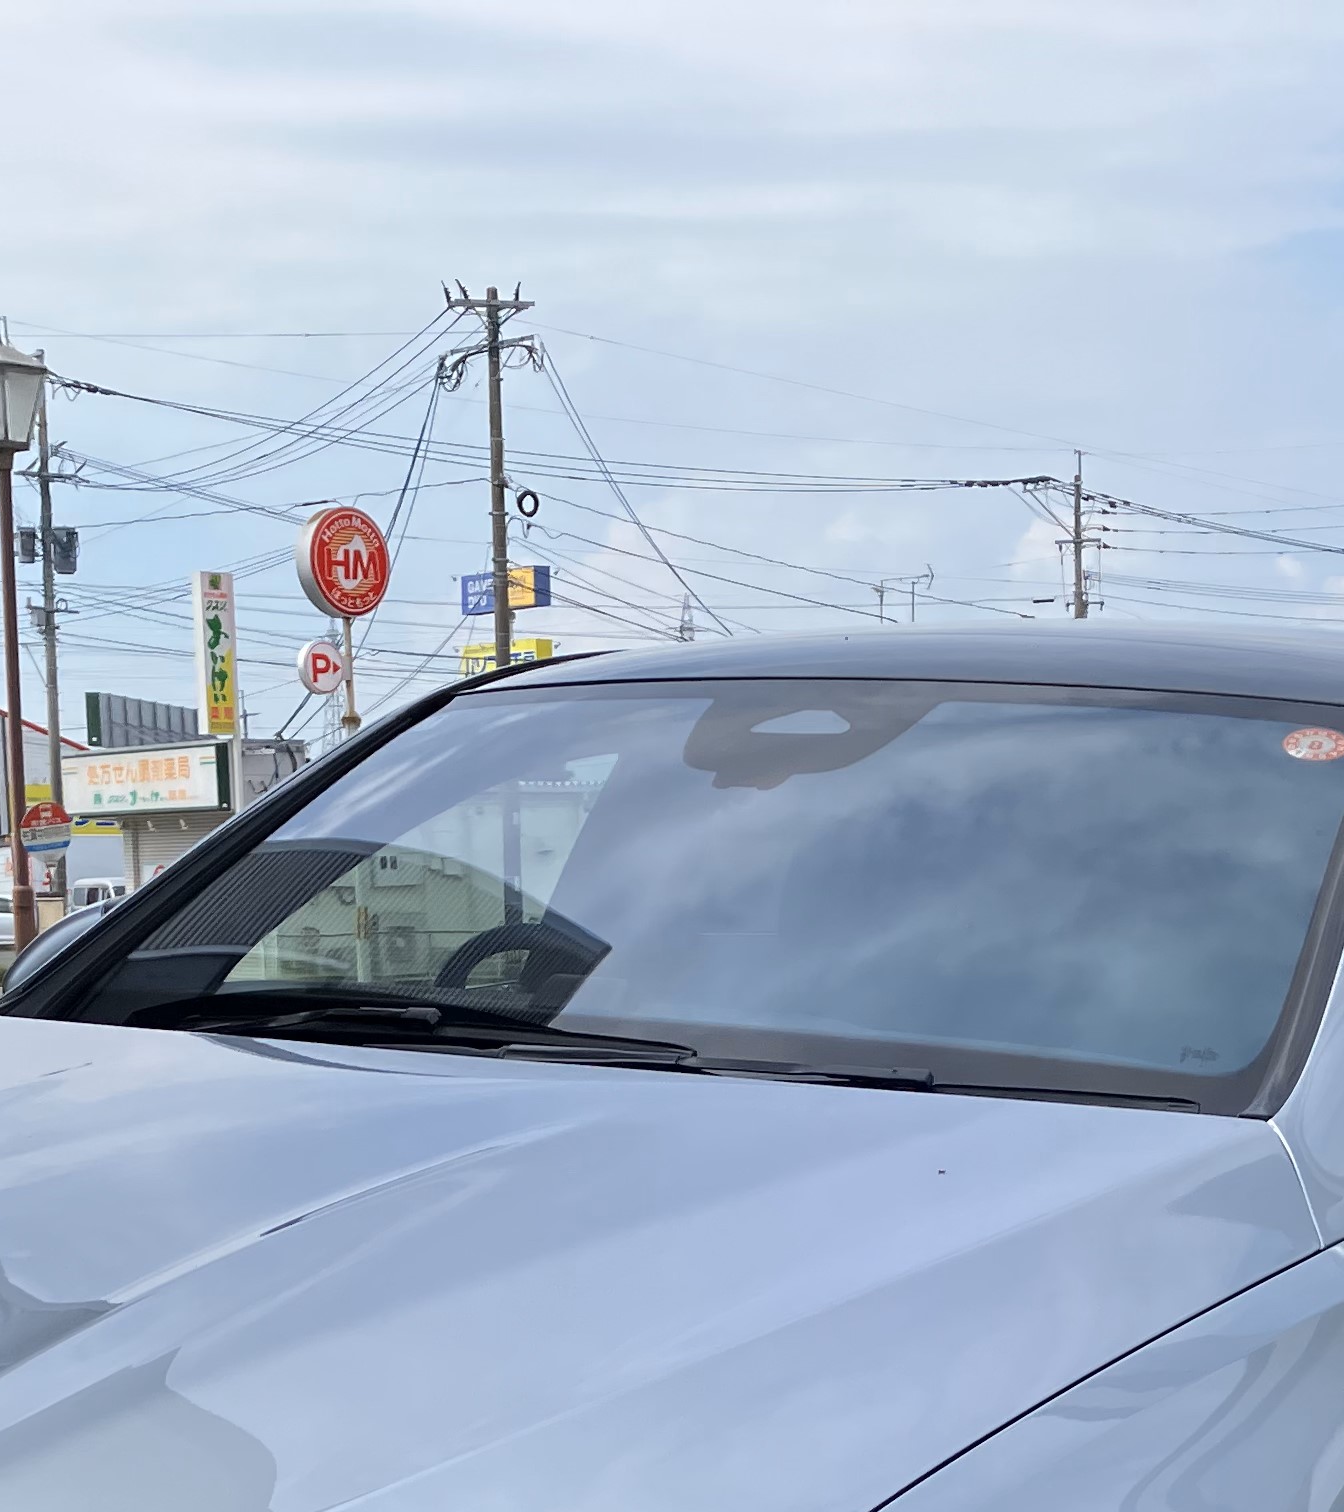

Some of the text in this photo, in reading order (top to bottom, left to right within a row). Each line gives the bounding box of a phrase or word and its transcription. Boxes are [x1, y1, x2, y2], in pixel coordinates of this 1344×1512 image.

[325, 546, 381, 584] HM
[330, 588, 377, 609] ほっともっと
[311, 652, 331, 683] P
